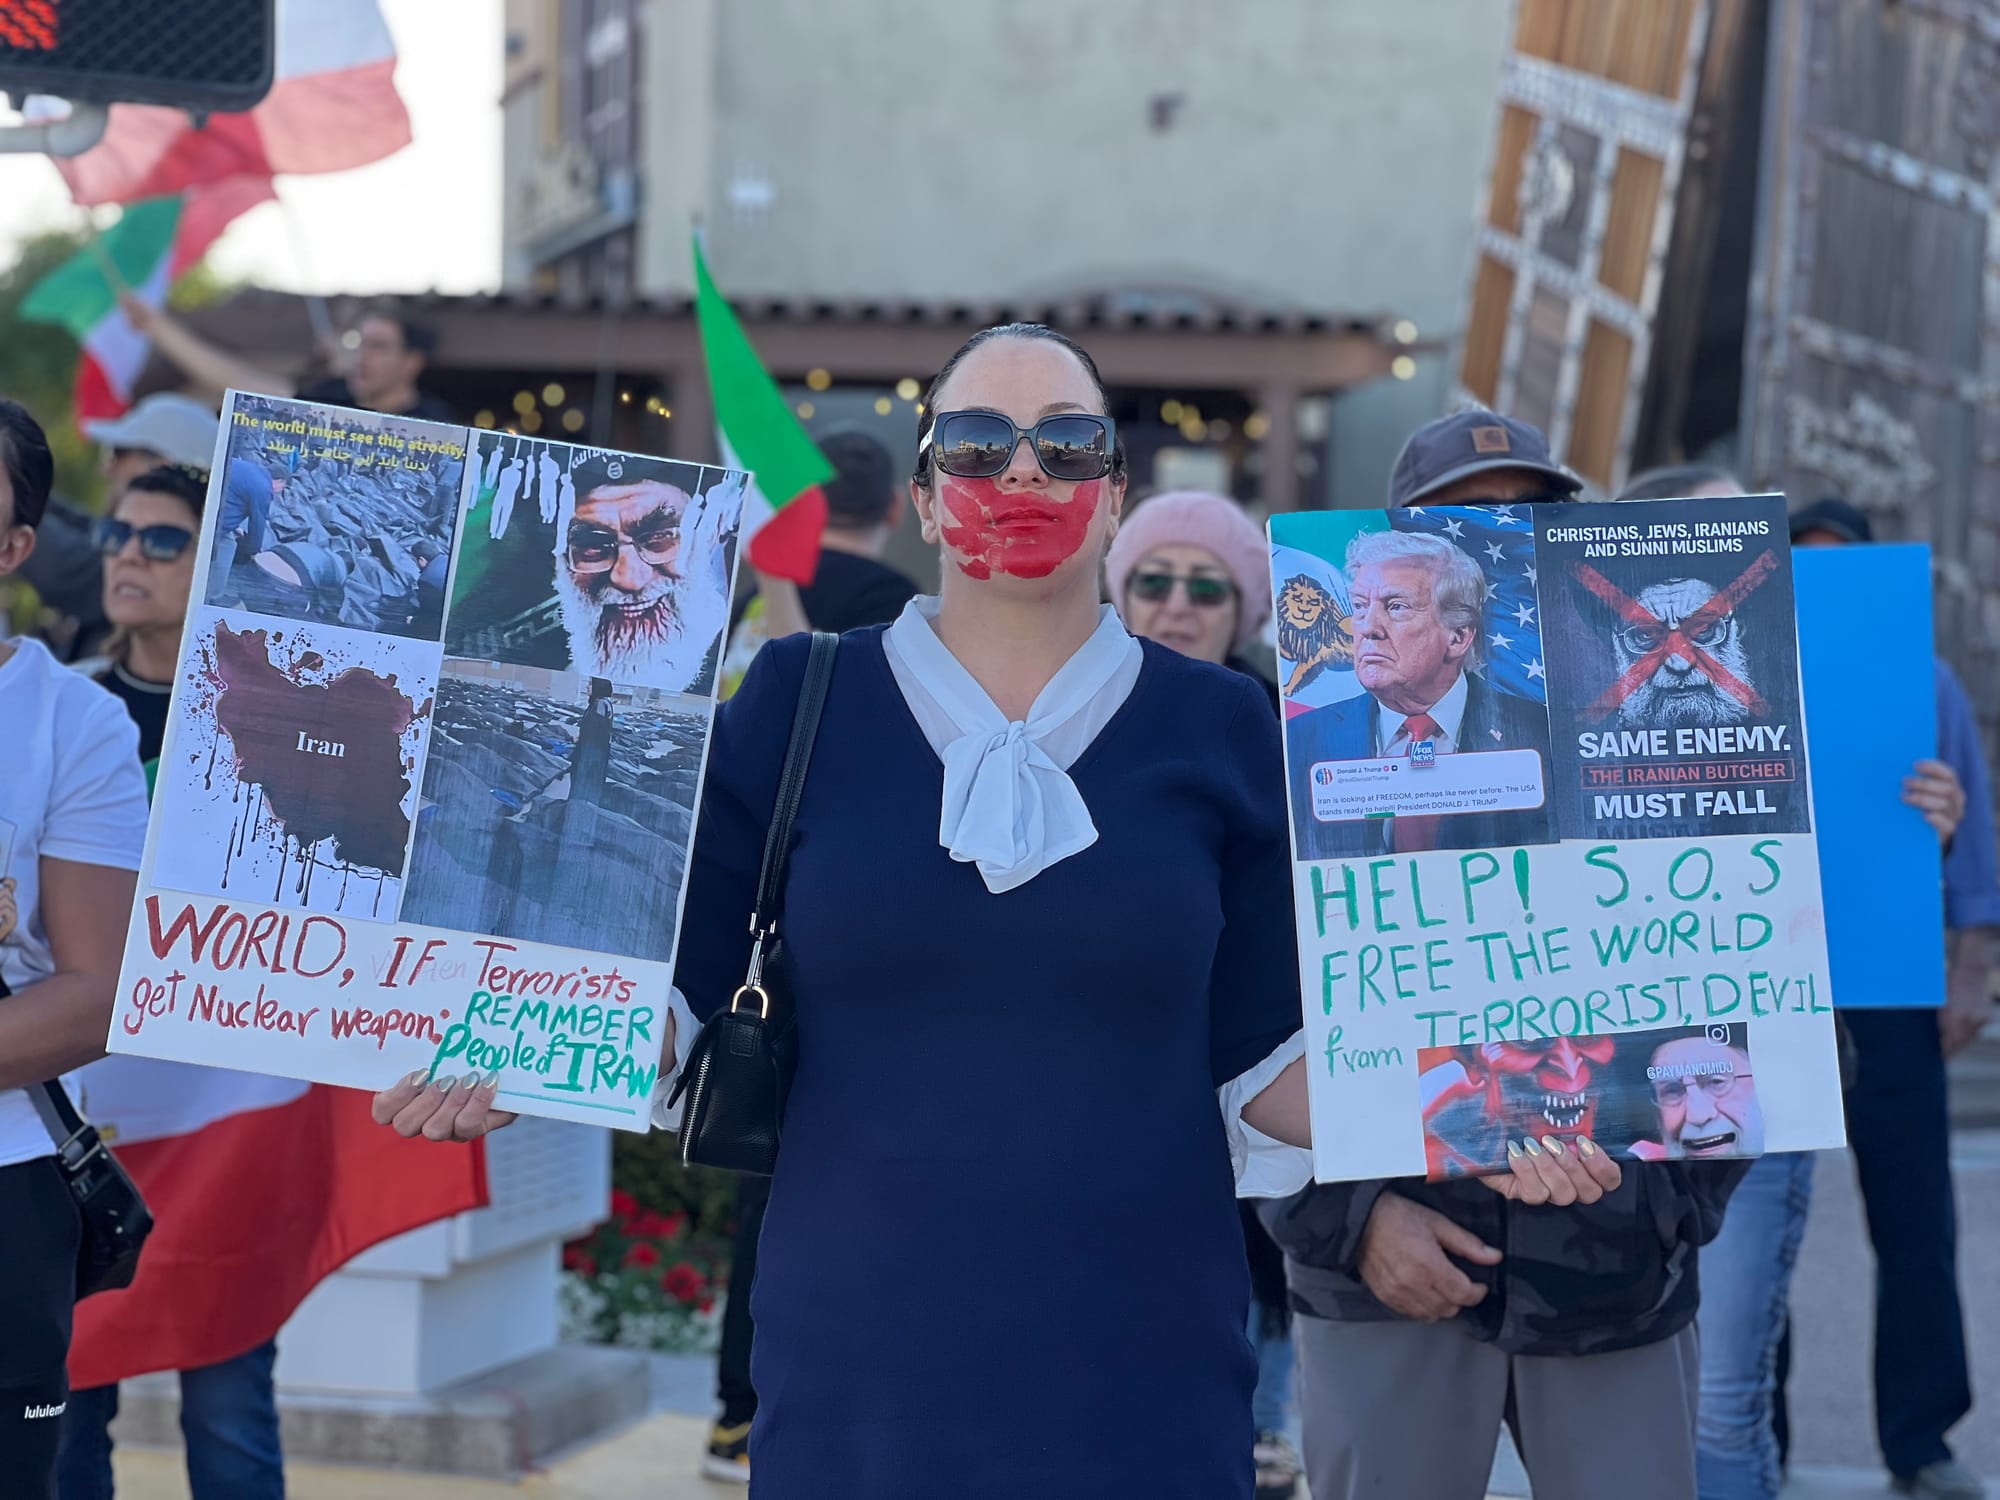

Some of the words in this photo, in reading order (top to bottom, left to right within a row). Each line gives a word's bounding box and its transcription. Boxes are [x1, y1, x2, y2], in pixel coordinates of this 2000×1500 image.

[232, 412, 260, 428] The
[263, 420, 306, 434] world
[308, 427, 346, 442] must
[349, 432, 374, 445] see
[377, 433, 405, 449] this
[407, 437, 467, 460] atrocity.
[1546, 525, 1644, 543] CHRISTIANS,
[1646, 523, 1693, 540] JEWS,
[1694, 520, 1770, 537] IRANIANS
[1584, 543, 1618, 558] AND
[1620, 541, 1669, 556] SUNNI
[1672, 537, 1744, 554] MUSLIMS
[296, 731, 345, 758] Iran
[1578, 729, 1669, 758] SAME
[1675, 725, 1792, 755] ENEMY.
[1341, 794, 1366, 804] looking
[1376, 791, 1414, 801] FREEDOM,
[1415, 789, 1443, 800] perhaps
[1458, 788, 1477, 796] never
[1506, 785, 1519, 793] The
[1521, 783, 1536, 792] USA
[1589, 769, 1622, 784] THE
[1627, 766, 1700, 782] IRANIAN
[1705, 763, 1786, 780] BUTCHER
[1319, 808, 1342, 816] stands
[1344, 805, 1364, 815] ready
[1366, 805, 1373, 813] to
[1398, 801, 1430, 812] President
[1432, 800, 1462, 809] DONALD
[1473, 798, 1498, 806] TRUMP
[1594, 793, 1686, 819] MUST
[1696, 790, 1777, 816] FALL
[1310, 848, 1534, 938] HELP!
[145, 894, 355, 988] WORLD,
[380, 936, 448, 987] IF
[472, 939, 638, 1003] Terrorists
[1321, 943, 1455, 1016] FREE
[1464, 926, 1571, 982] THE
[1590, 910, 1774, 967] WORLD
[124, 969, 187, 1035] get
[187, 983, 320, 1038] Nuclear
[1702, 970, 1832, 1018] DEVIL
[464, 989, 654, 1052] REMMBER
[542, 1041, 657, 1098] IRAN
